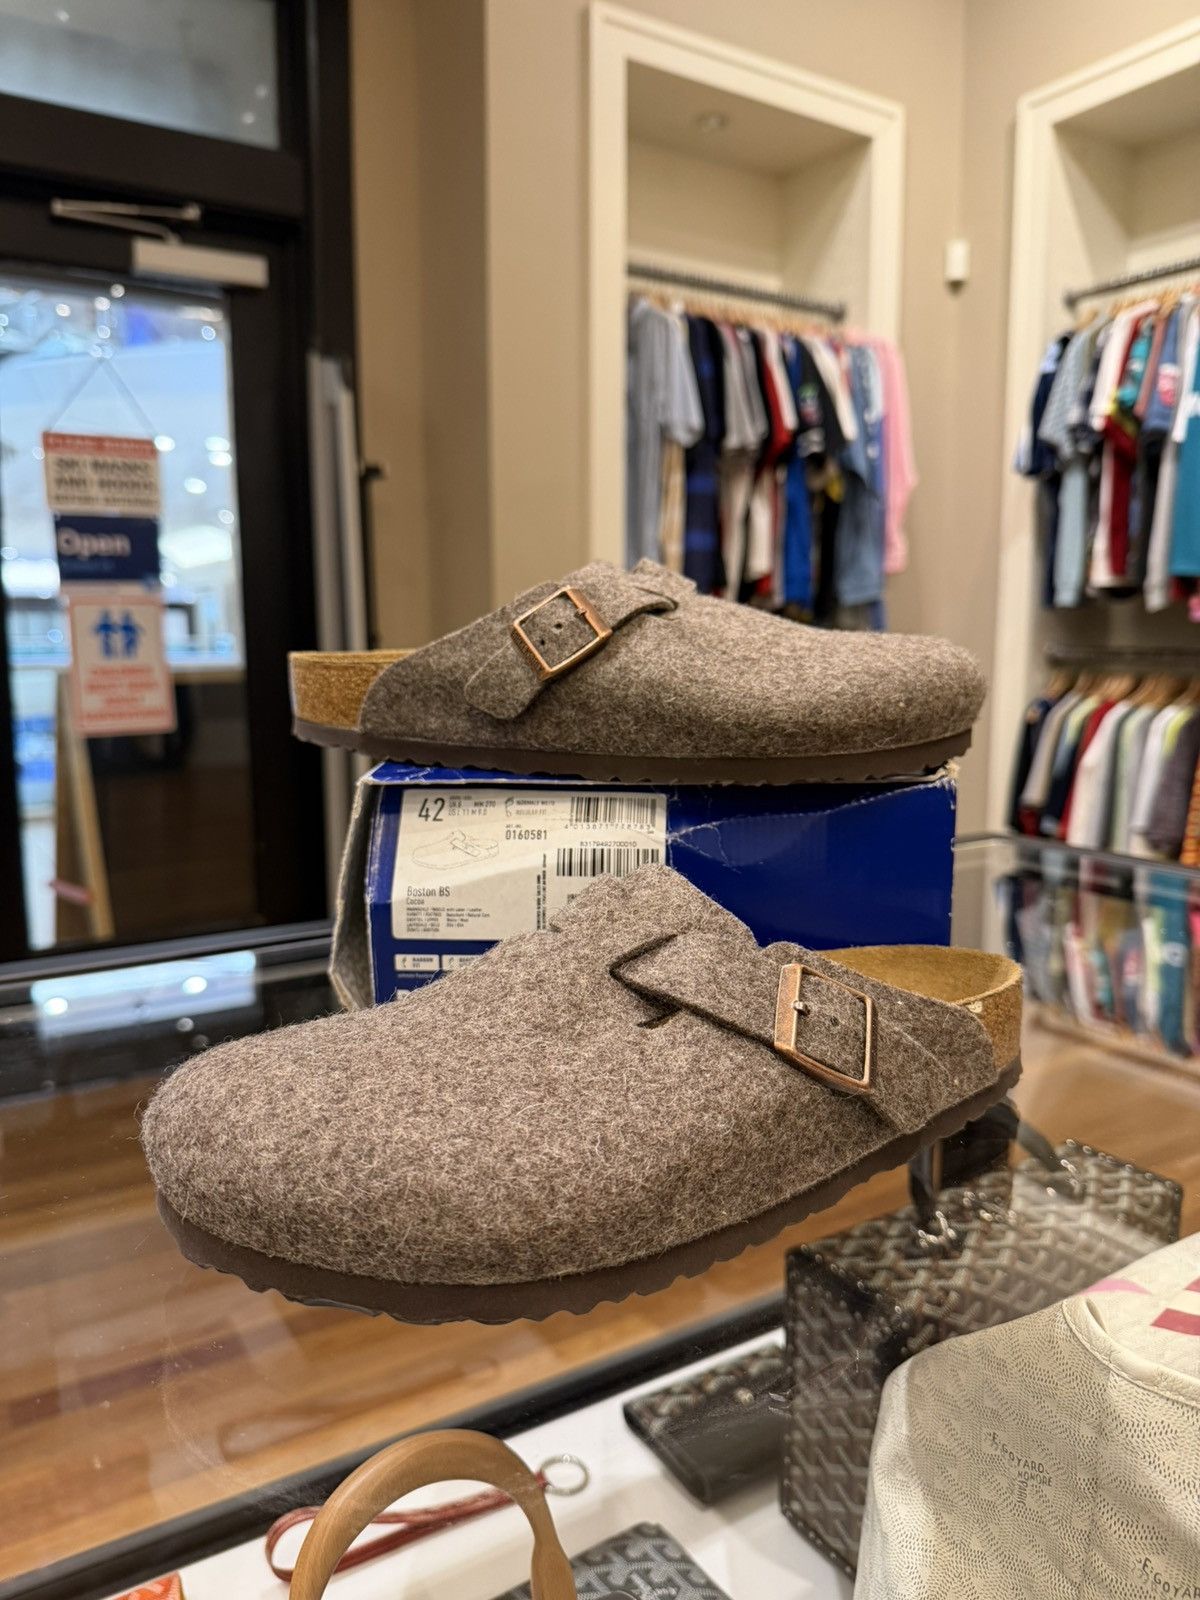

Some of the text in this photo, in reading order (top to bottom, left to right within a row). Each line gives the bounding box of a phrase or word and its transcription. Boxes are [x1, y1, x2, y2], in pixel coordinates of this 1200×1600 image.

[57, 528, 131, 561] Open
[418, 798, 445, 822] 42
[505, 829, 547, 840] 0160581
[407, 886, 450, 897] Boston BS
